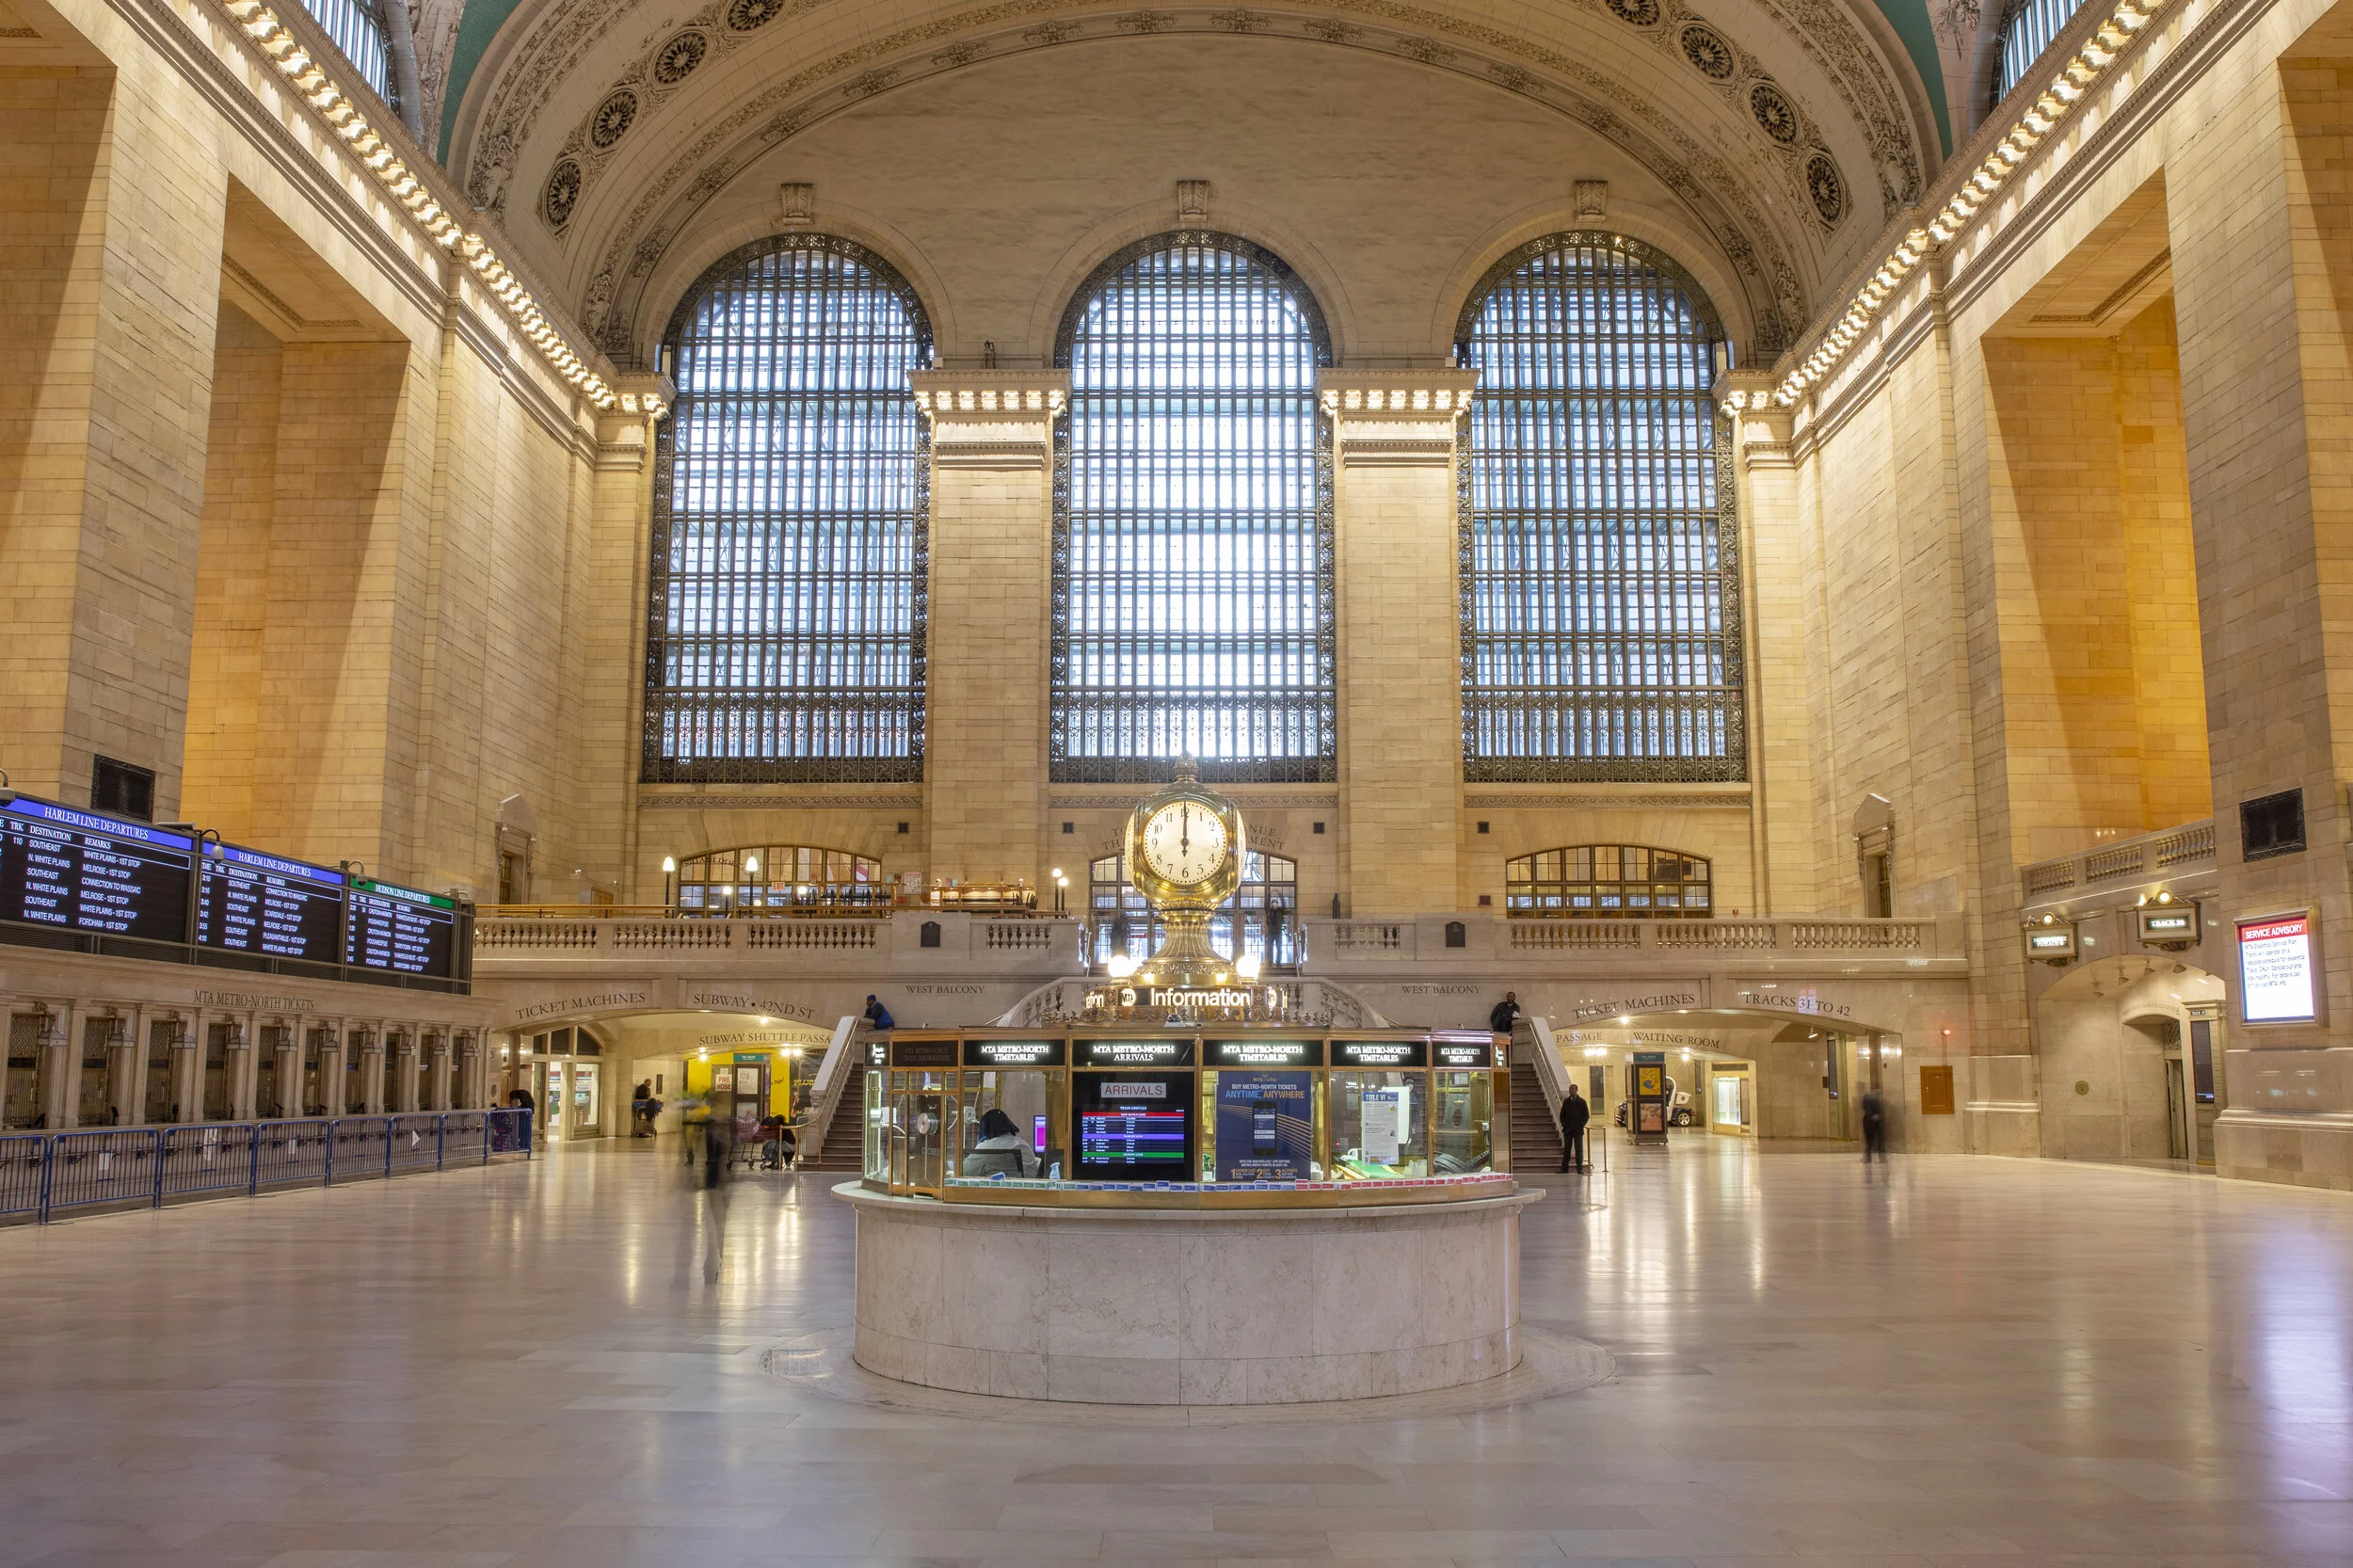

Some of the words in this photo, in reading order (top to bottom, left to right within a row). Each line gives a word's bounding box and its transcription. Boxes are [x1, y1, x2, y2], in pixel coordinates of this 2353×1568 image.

[45, 807, 79, 824] HARLEM
[81, 816, 99, 828] LINE
[101, 820, 148, 840] DEPARTURES
[1166, 813, 1172, 822] 11
[1154, 824, 1162, 834] 10
[1209, 821, 1215, 831] 2
[10, 821, 24, 831] TRK
[30, 825, 72, 841] DESTINATION
[85, 837, 111, 849] REMARKS
[1152, 838, 1158, 849] 9
[1212, 838, 1219, 848] 3
[13, 837, 23, 845] 110
[29, 840, 61, 852] SOUTHEAST
[84, 850, 99, 860] WHITE
[99, 854, 116, 864] PLAINS
[1156, 854, 1162, 865] 8
[1209, 853, 1215, 863] 4
[35, 855, 51, 865] WHITE
[51, 857, 70, 868] PLAINS
[83, 864, 106, 875] MELROSE
[118, 871, 131, 879] STOP
[239, 852, 263, 866] HARLEM
[263, 858, 277, 869] LINE
[278, 861, 312, 877] DEPARTURES
[1167, 864, 1173, 874] 7
[1197, 864, 1203, 875] 5
[229, 868, 258, 880] DESTINATION
[1182, 867, 1189, 878] 6
[27, 867, 59, 880] SOUTHEAST
[82, 877, 113, 889] CONNECTION
[120, 884, 141, 894] WASSAIC
[228, 880, 251, 890] SOUTHEAST
[32, 882, 50, 893] WHITE
[50, 885, 68, 895] PLAINS
[80, 891, 104, 901] MELROSE
[116, 896, 129, 904] STOP
[375, 884, 394, 896] HUDSON
[395, 889, 404, 897] LINE
[405, 891, 430, 904] DEPARTURES
[25, 896, 57, 907] SOUTHEAST
[80, 904, 96, 913] WHITE
[96, 906, 113, 916] PLAINS
[226, 903, 249, 912] SOUTHEAST
[31, 911, 48, 920] WHITE
[48, 913, 66, 923] PLAINS
[79, 917, 103, 927] FORDHAM
[115, 923, 128, 931] STOP
[225, 926, 248, 936] SOUTHEAST
[2245, 928, 2270, 939] SERVICE
[2271, 924, 2303, 936] ADVISORY
[224, 938, 247, 947] SOUTHEAST
[936, 986, 985, 994] BALCONY
[1402, 986, 1430, 994] WEST
[1433, 986, 1481, 994] BALCONY
[194, 990, 213, 1004] MTA
[283, 997, 314, 1011] TICKETS
[1151, 988, 1251, 1006] Information
[515, 1000, 568, 1020] TICKET
[571, 993, 646, 1009] MACHINES
[693, 993, 750, 1008] SUBWAY
[759, 1000, 795, 1016] 42ND
[797, 1007, 815, 1020] ST
[1572, 1001, 1619, 1019] TICKET
[1625, 993, 1695, 1011] MACHINES
[1743, 993, 1796, 1007] TRACKS
[1798, 998, 1812, 1009] 31
[1815, 1000, 1834, 1013] TO
[1836, 1005, 1850, 1016] 42
[700, 1033, 745, 1045] SUBWAY
[748, 1033, 797, 1041] SHUTTLE
[801, 1034, 831, 1043] PASSA
[1556, 1031, 1603, 1043] PASSAGE
[1633, 1032, 1683, 1044] WAITING
[1688, 1036, 1721, 1049] ROOM
[1104, 1085, 1163, 1095] ARRIVALS
[1225, 1090, 1261, 1099] ANYTIME,
[1263, 1091, 1305, 1099] ANYWHERE
[921, 1147, 940, 1155] COSED
[1231, 1169, 1236, 1179] 1
[1257, 1169, 1263, 1179] 2
[1275, 1169, 1281, 1179] 3
